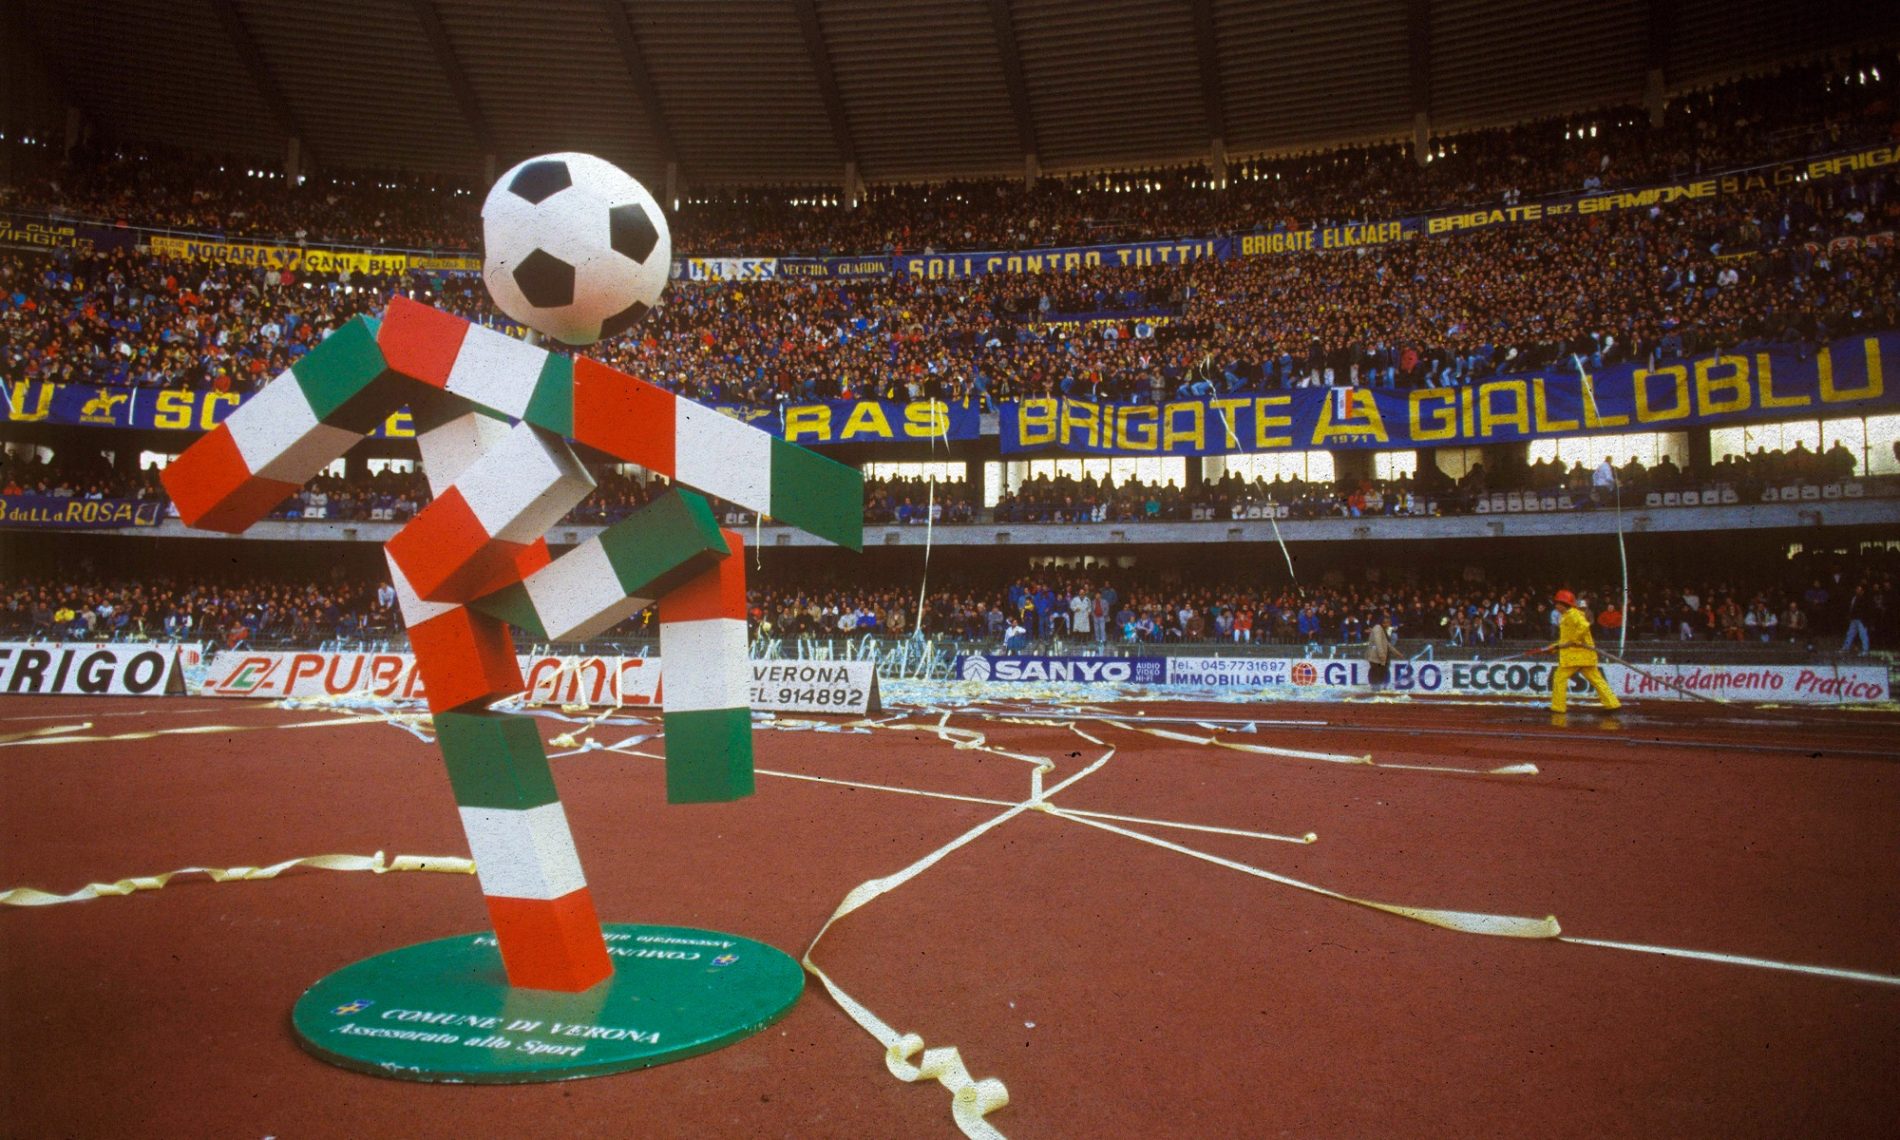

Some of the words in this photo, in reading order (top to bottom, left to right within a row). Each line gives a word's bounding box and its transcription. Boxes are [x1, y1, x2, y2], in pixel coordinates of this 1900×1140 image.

[1428, 204, 1543, 234] BRIGATE
[1578, 181, 1717, 215] SIRMIONE
[26, 223, 76, 236] CLUB
[1242, 231, 1315, 256] BRIGATE
[1323, 222, 1401, 249] ELKJAER
[188, 243, 268, 262] NOGARA
[307, 255, 350, 269] CANI
[370, 259, 403, 271] BLU
[784, 262, 829, 276] VECCHIA
[838, 260, 886, 275] GUARDIA
[1019, 396, 1292, 451] BRIGATE
[1409, 338, 1884, 442] GIALLOBLU
[65, 501, 132, 523] ROSA
[753, 666, 850, 683] VERONA
[995, 660, 1131, 681] SANYO
[1136, 668, 1161, 676] VIDEO
[1171, 674, 1286, 686] IMMOBILIARE
[1624, 669, 1784, 694] L'Arredamento
[1795, 670, 1885, 700] Pratico
[750, 687, 773, 703] EL.
[778, 687, 864, 706] 914892
[381, 1008, 504, 1030] COMUNE
[506, 1018, 544, 1033] DI
[550, 1022, 660, 1045] VERONA
[329, 1023, 460, 1045] Assessorato
[463, 1034, 511, 1050] allo
[516, 1039, 587, 1058] Sport
